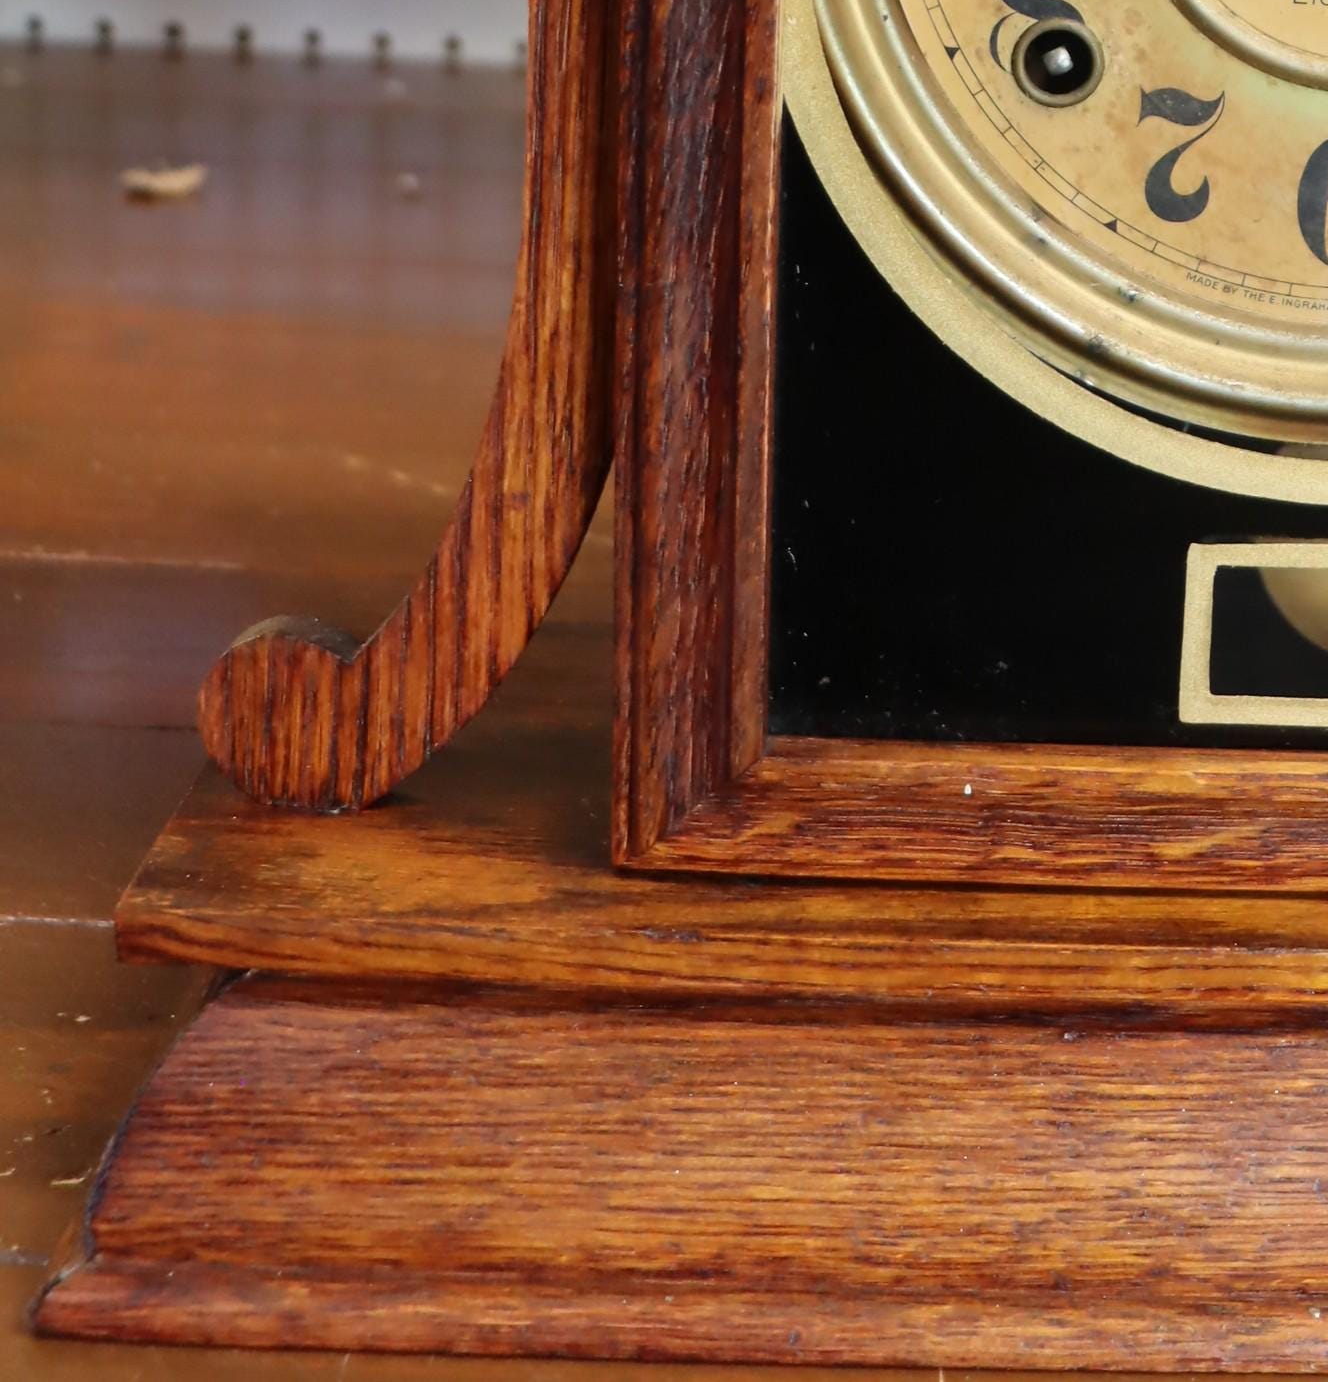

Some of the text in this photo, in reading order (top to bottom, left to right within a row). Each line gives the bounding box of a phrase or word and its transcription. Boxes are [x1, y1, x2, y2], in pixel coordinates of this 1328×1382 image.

[1136, 86, 1225, 223] 7
[1186, 271, 1220, 291] MADE
[1222, 284, 1239, 295] BY
[1243, 289, 1266, 303] THE
